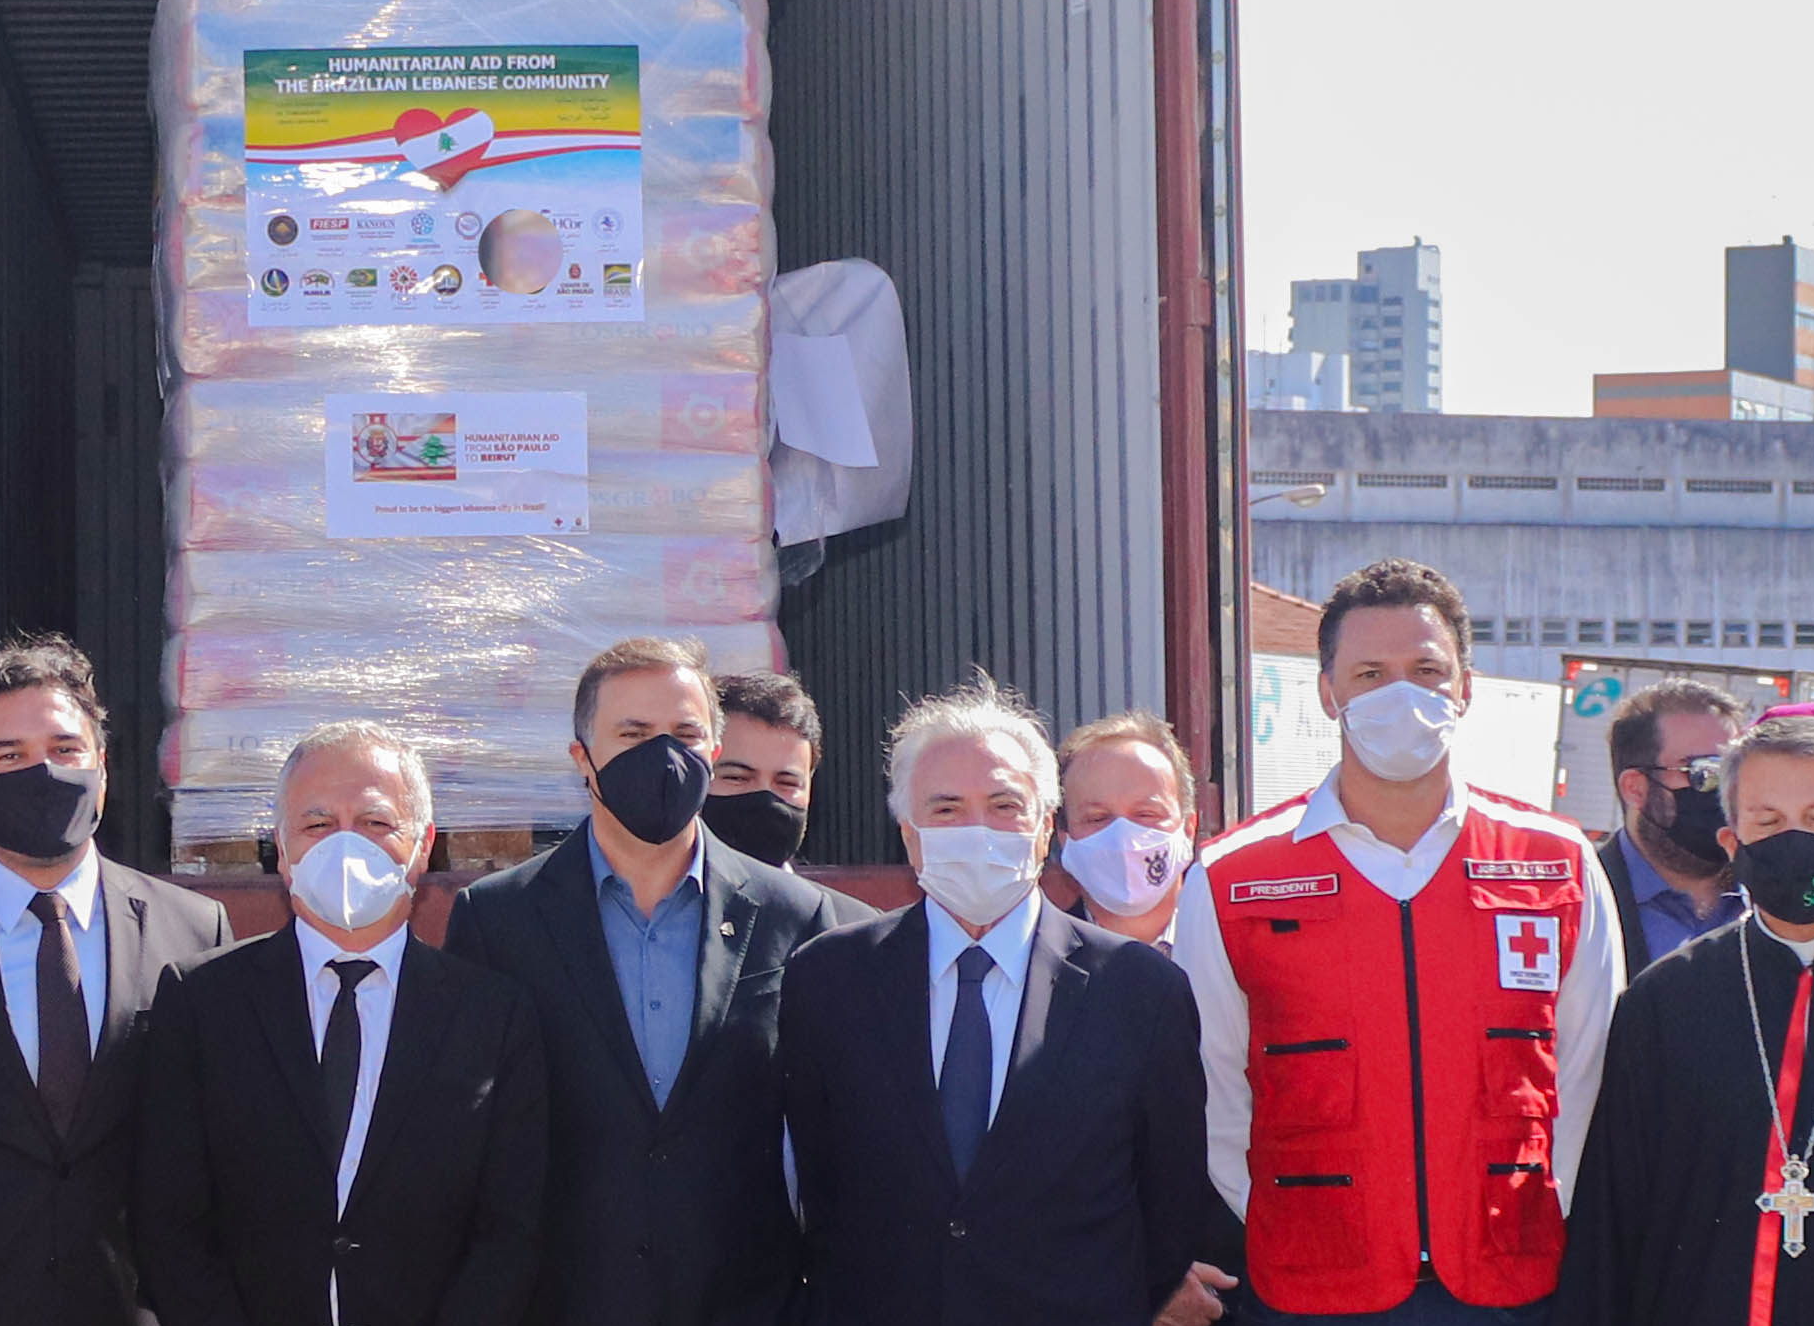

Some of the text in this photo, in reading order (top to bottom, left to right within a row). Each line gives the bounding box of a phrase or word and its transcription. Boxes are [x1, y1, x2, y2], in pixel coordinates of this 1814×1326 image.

[328, 54, 556, 72] HUMANITARIAN AID FROM
[275, 73, 610, 93] THE BRAZILIAN LEBANESE COMMUNITY
[312, 218, 348, 229] FIESP
[464, 433, 560, 443] HUMANITARIAN AID
[465, 442, 551, 452] FROM SÃO PAULO
[466, 454, 516, 462] TO BEIRUT
[1249, 880, 1319, 896] PRESIDENTE
